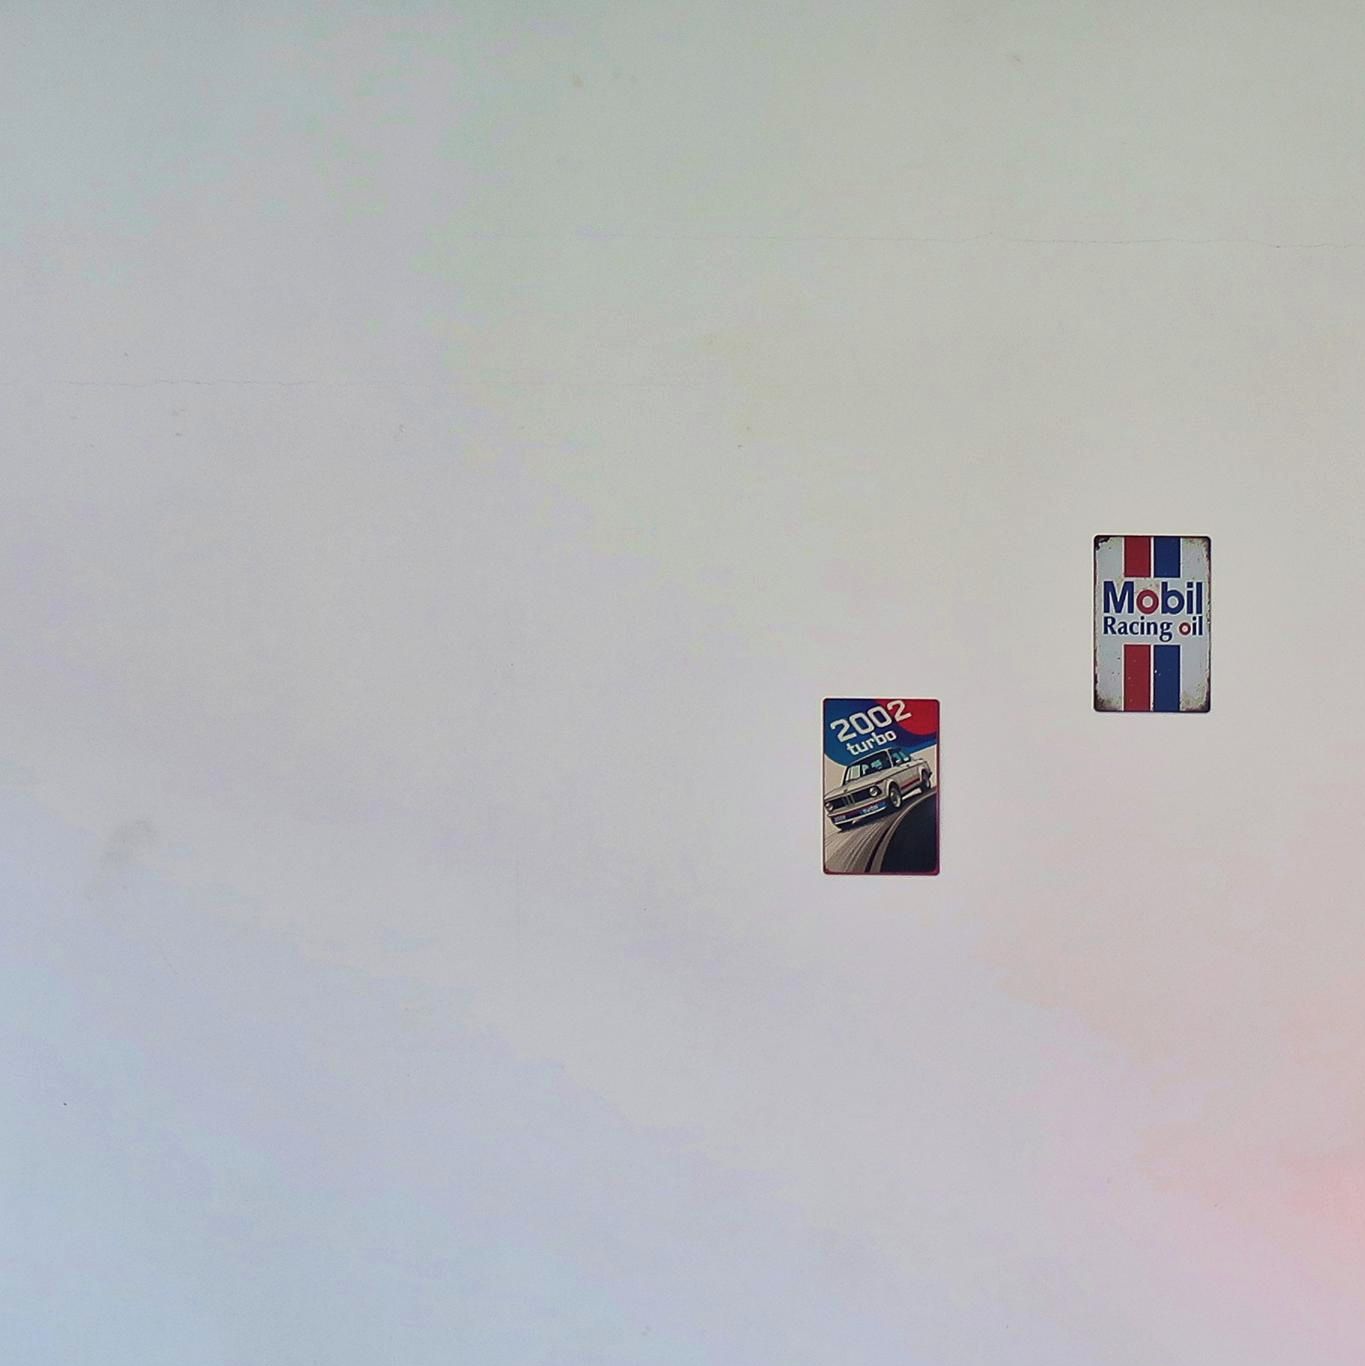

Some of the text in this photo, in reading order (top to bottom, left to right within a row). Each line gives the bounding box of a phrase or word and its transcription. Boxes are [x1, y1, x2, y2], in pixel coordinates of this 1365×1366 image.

[1103, 580, 1203, 615] Mobil
[1103, 616, 1203, 643] Racing oil
[830, 700, 912, 743] 2002
[846, 730, 897, 756] turbo
